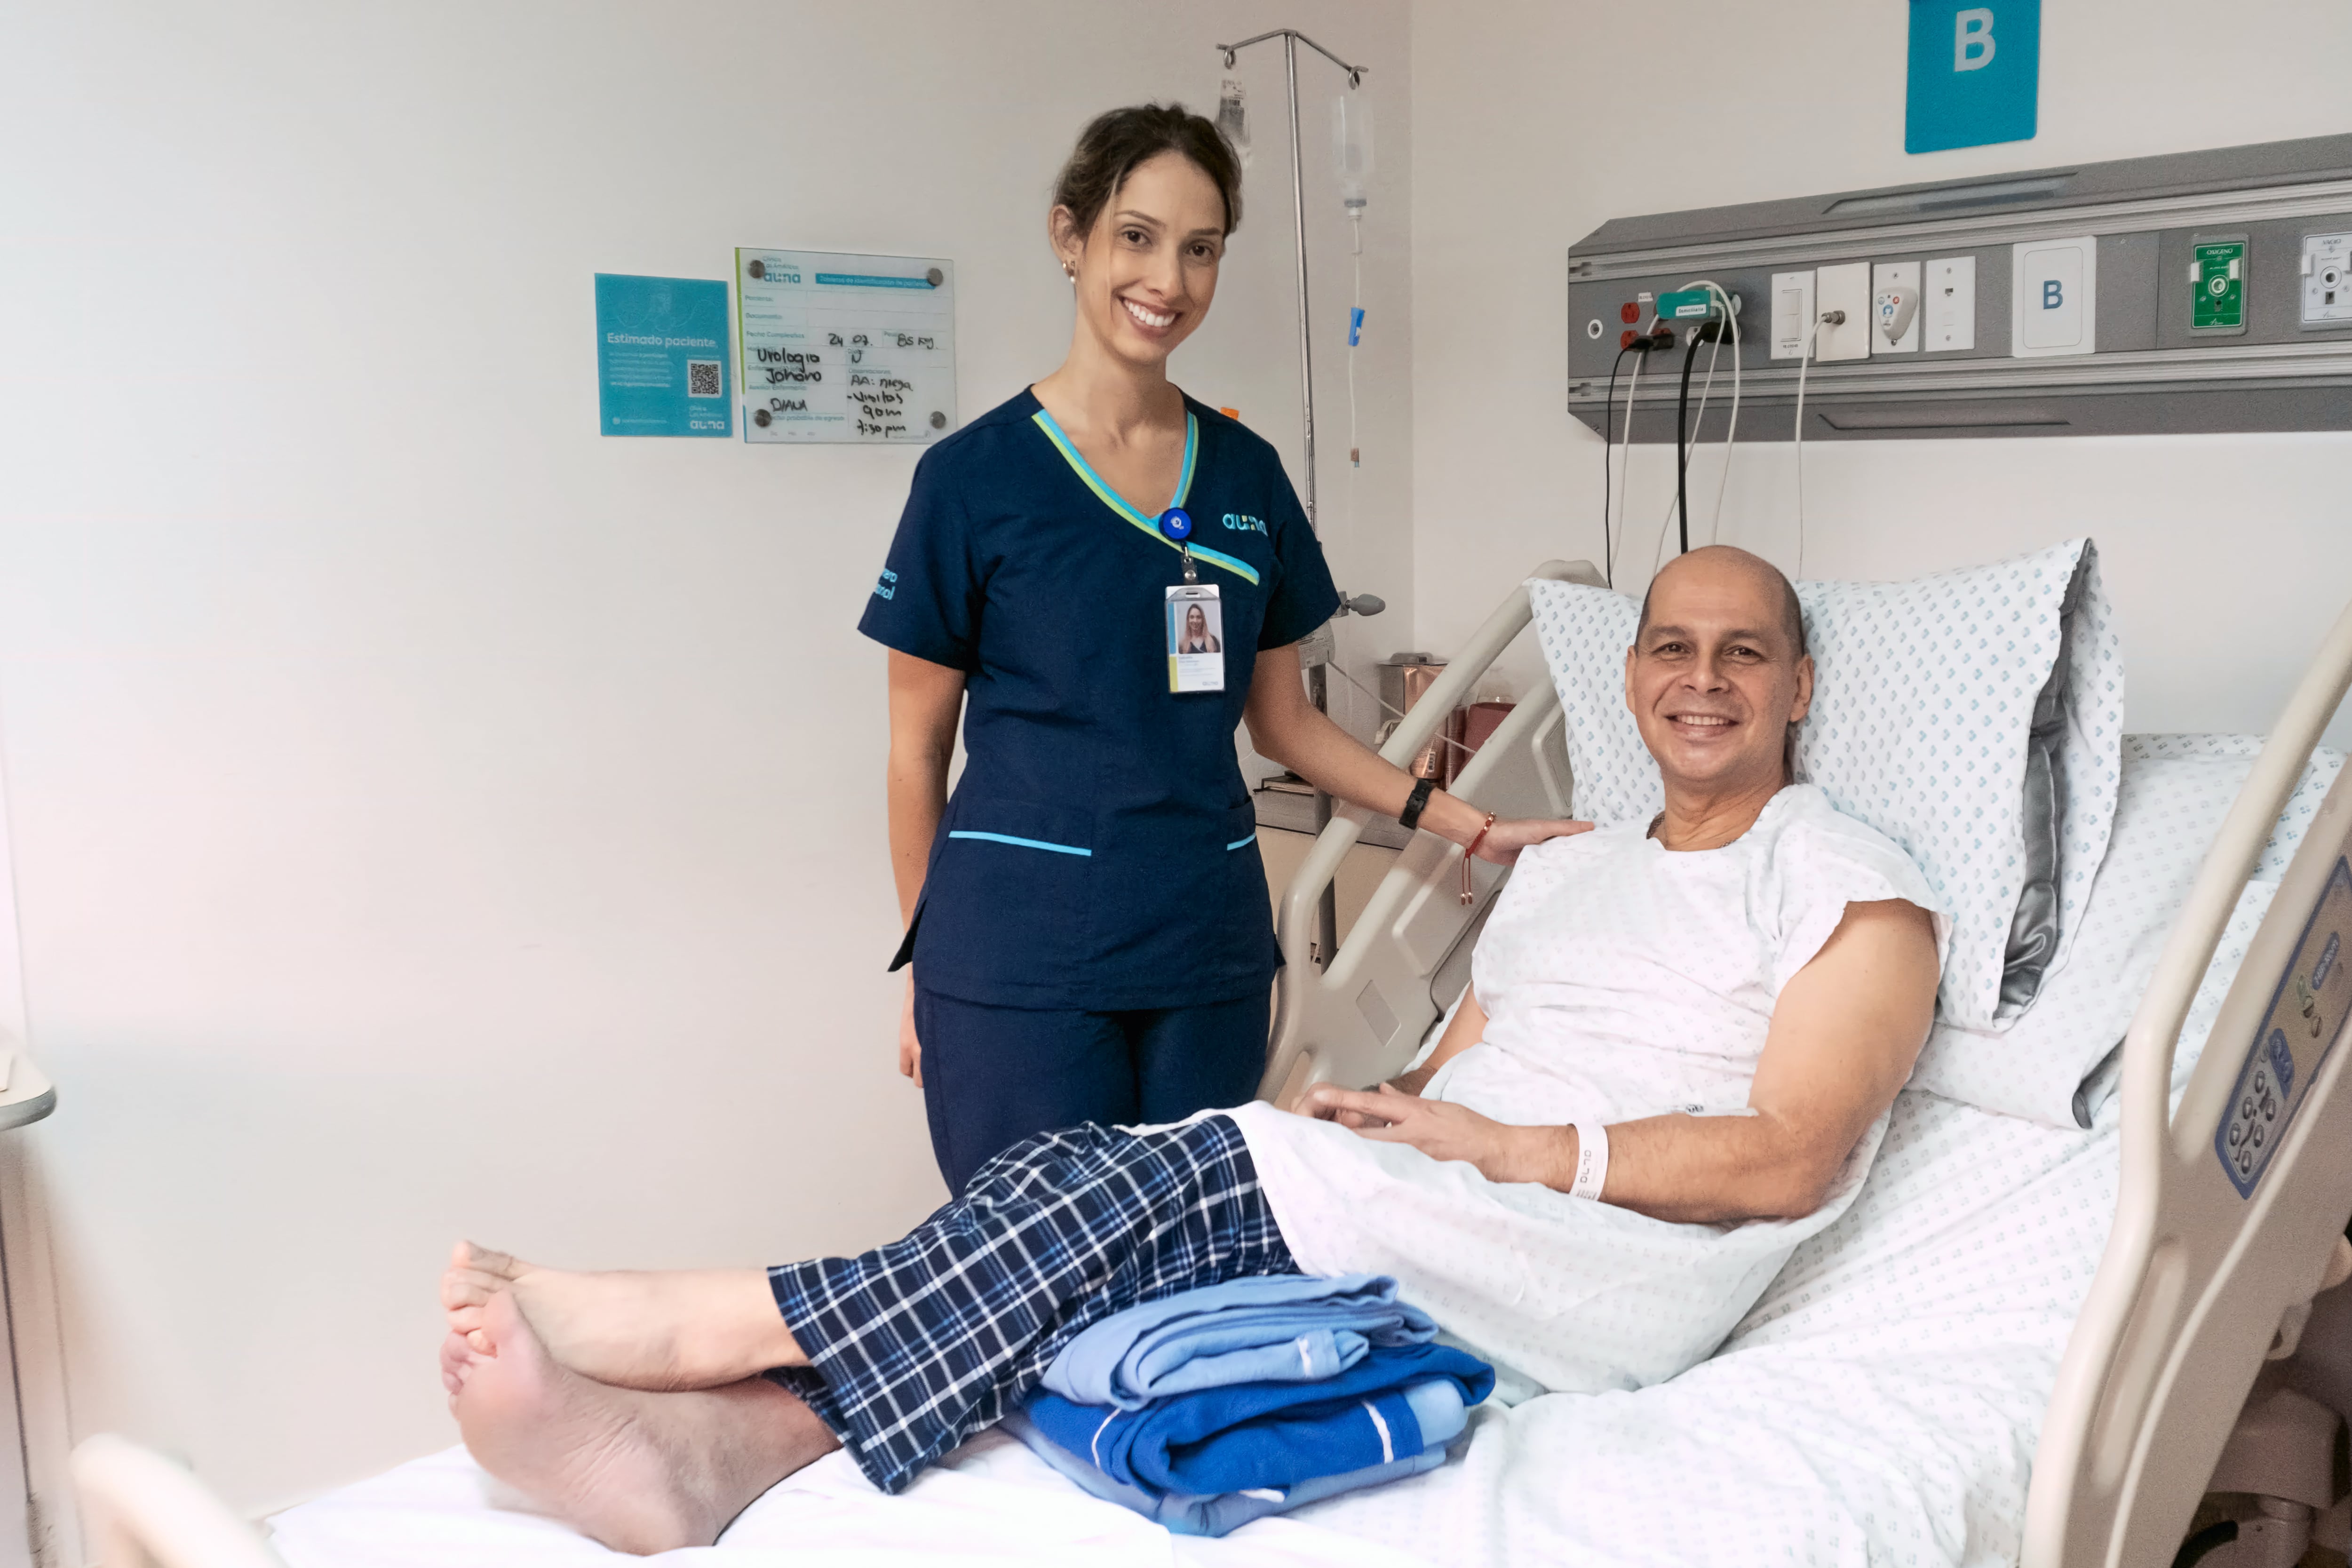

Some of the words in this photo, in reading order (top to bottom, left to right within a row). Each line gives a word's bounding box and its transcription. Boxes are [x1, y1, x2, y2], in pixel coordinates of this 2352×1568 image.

[1954, 7, 1996, 72] B
[2043, 279, 2063, 310] B
[607, 332, 663, 346] Estimado
[828, 333, 843, 347] 24
